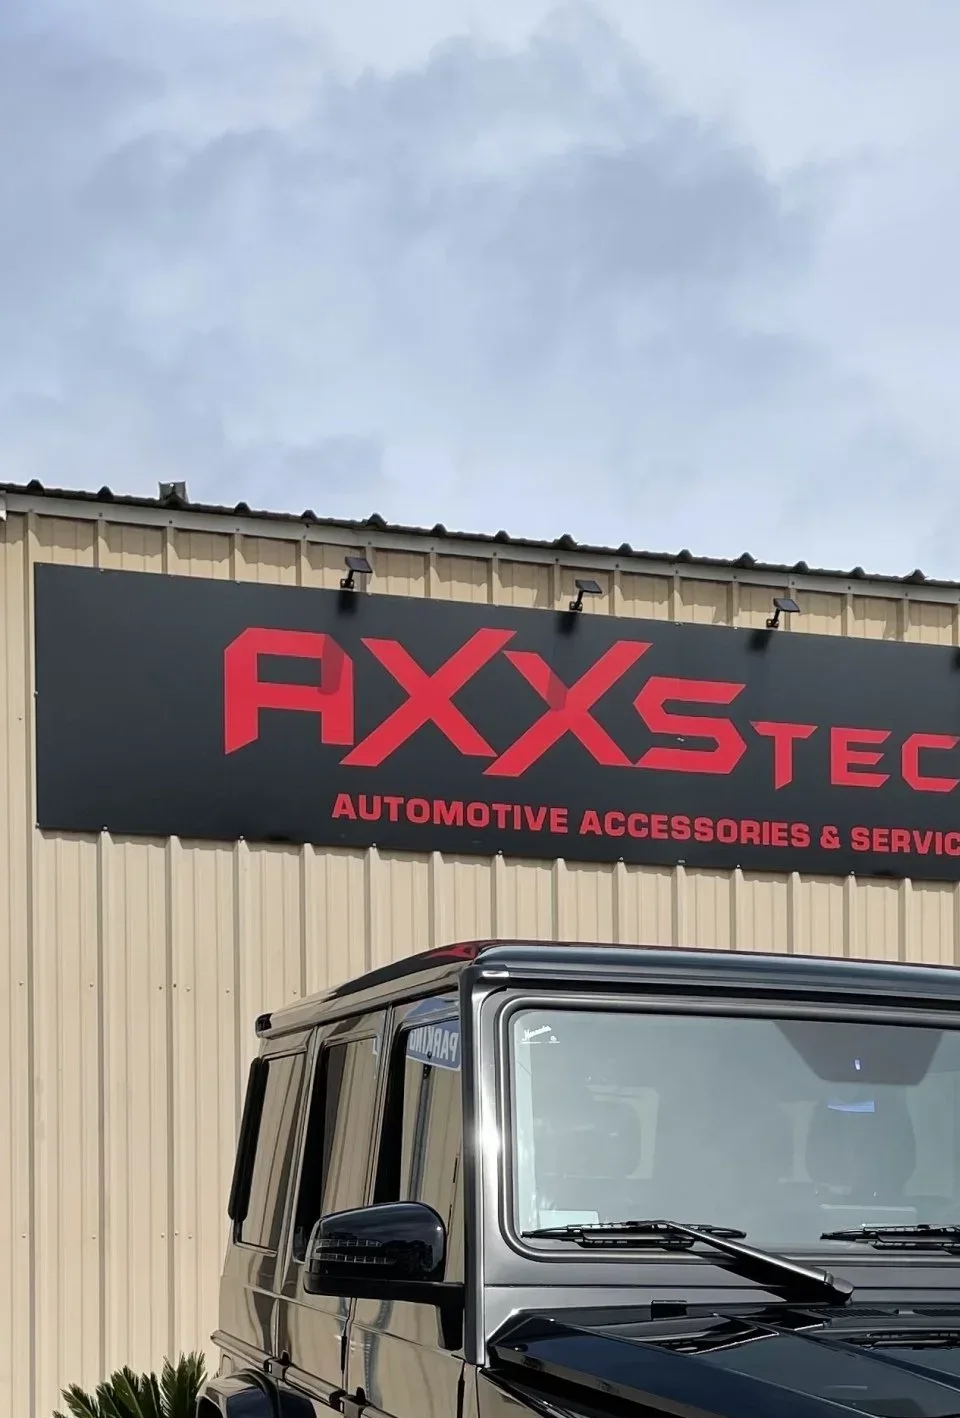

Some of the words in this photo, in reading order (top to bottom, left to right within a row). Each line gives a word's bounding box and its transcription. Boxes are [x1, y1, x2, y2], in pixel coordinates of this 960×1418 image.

[332, 793, 569, 834] AUTOMOTIVE
[579, 810, 811, 848] ACCESSORIES
[819, 825, 841, 850] &
